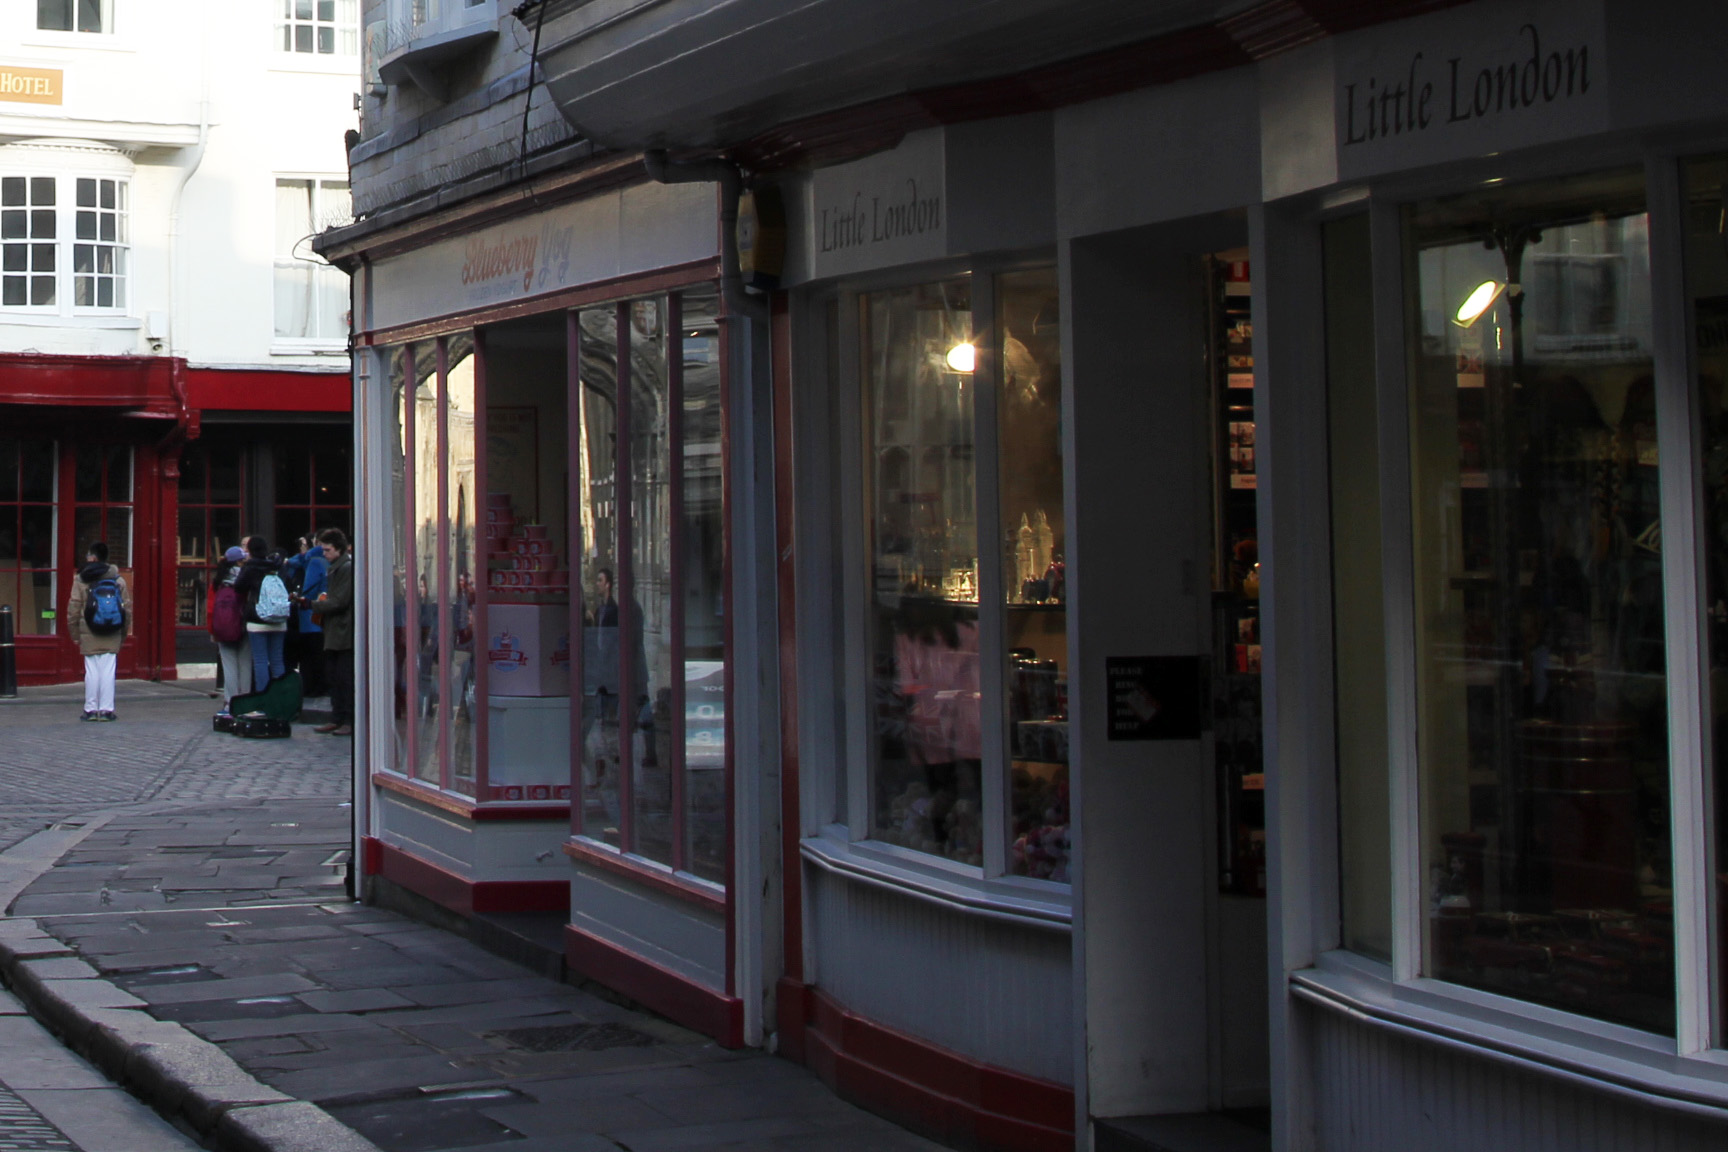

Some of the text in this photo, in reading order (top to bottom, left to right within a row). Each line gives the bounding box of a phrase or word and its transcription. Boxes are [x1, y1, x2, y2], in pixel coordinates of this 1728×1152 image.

[0, 73, 54, 96] HOTEL
[1344, 24, 1591, 146] Little London
[821, 178, 940, 252] Little London
[462, 231, 538, 292] Blueberry
